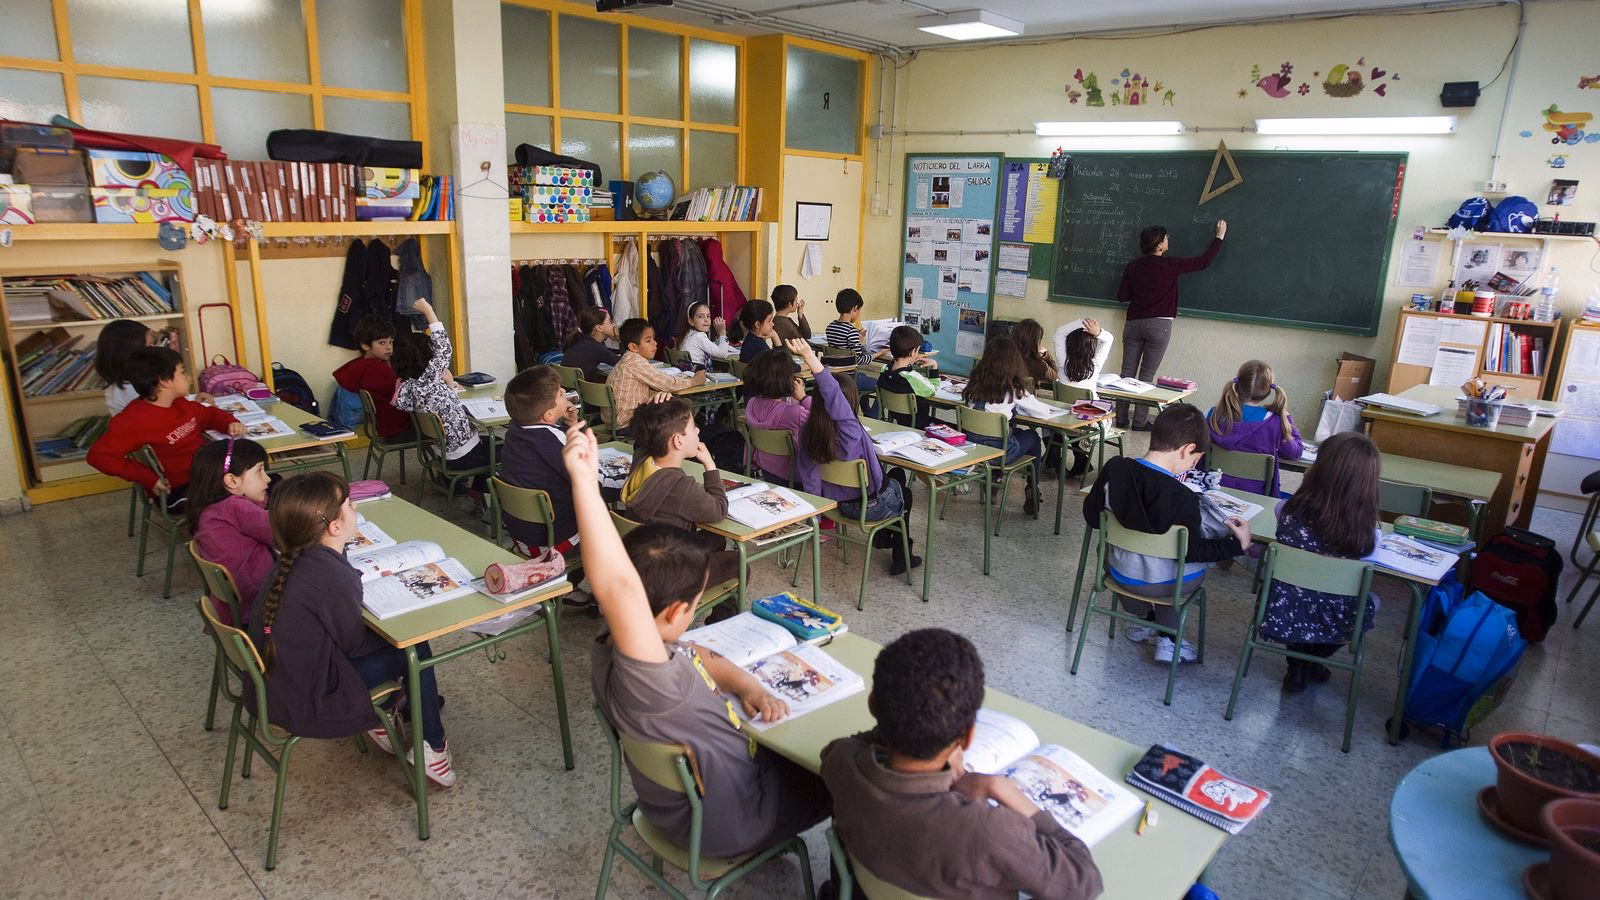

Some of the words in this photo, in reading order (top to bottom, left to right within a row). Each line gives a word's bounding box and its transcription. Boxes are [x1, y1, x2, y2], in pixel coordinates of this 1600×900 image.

[913, 162, 947, 171] NOTICIERO
[949, 162, 960, 170] DEL
[967, 162, 990, 170] LARRA
[1109, 168, 1120, 178] 28
[1158, 168, 1178, 179] 2012
[967, 177, 992, 186] SALIDAS
